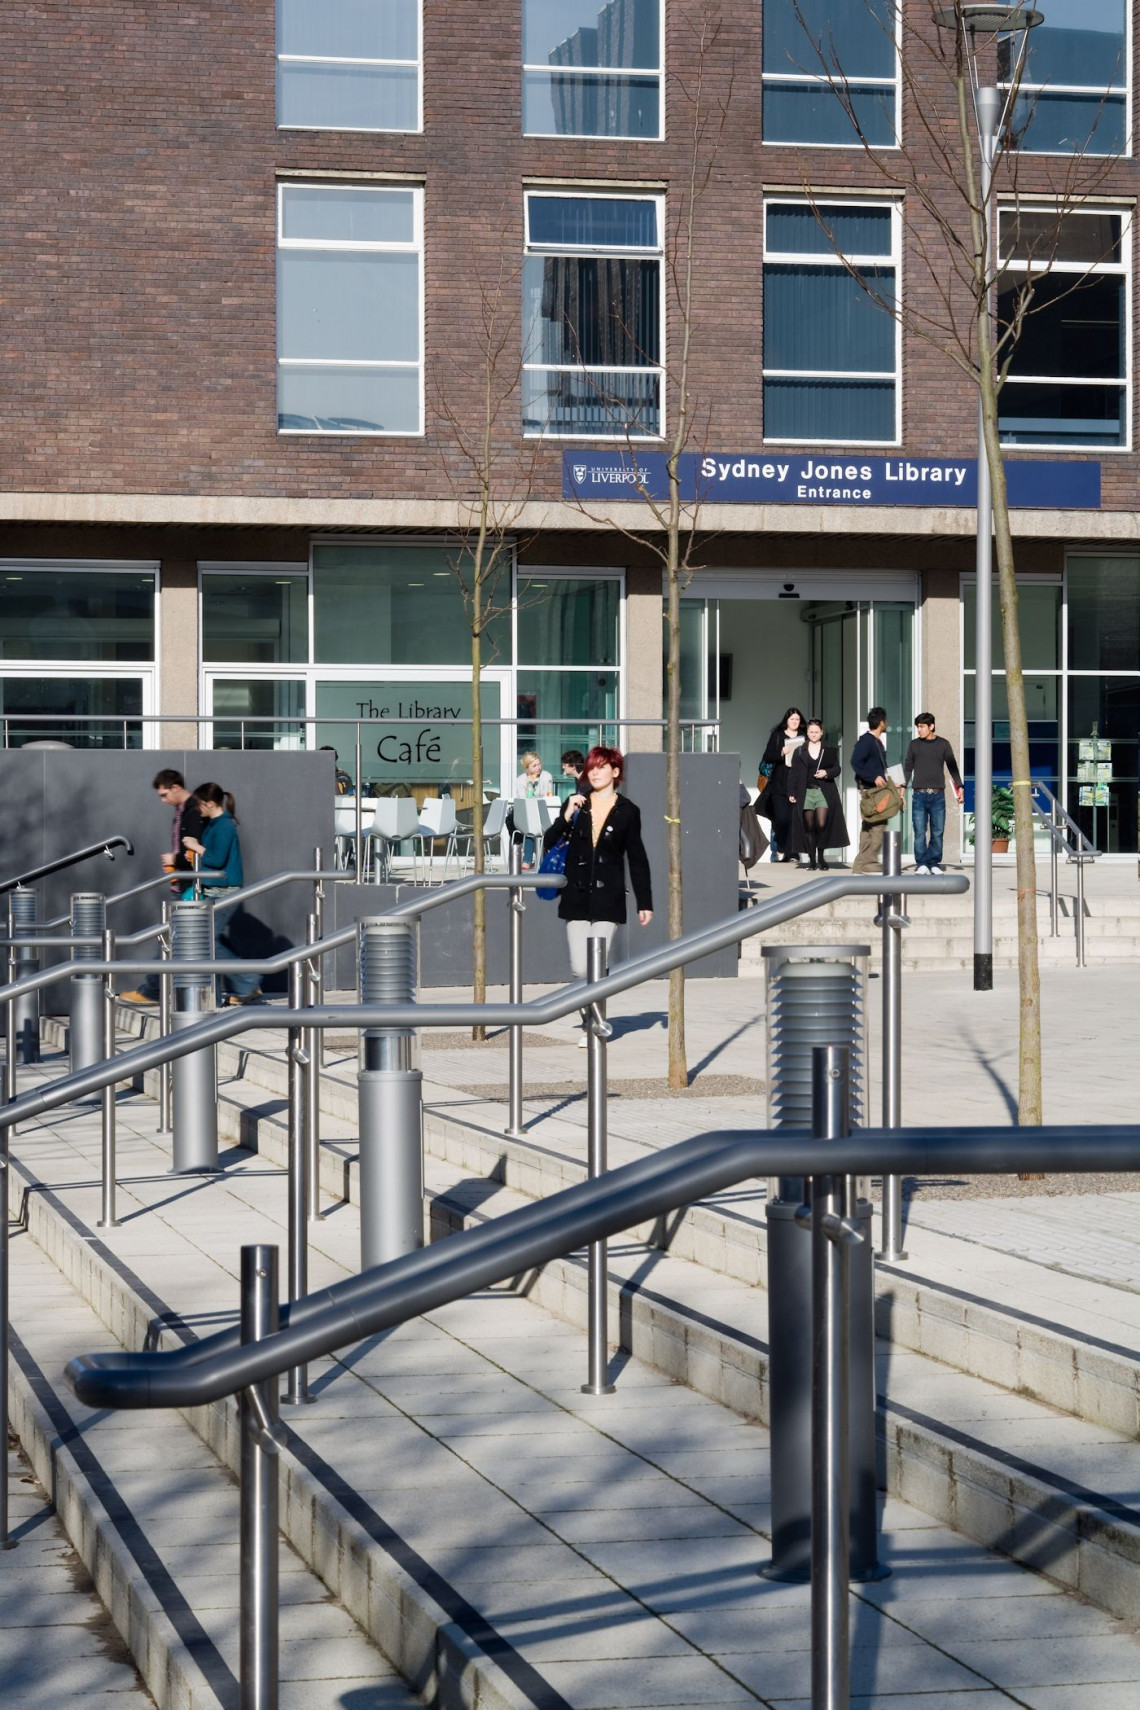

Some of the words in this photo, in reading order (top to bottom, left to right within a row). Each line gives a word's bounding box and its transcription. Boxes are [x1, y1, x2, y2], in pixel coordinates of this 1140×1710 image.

[591, 473, 649, 484] LIVERPOOL
[701, 458, 790, 482] Sydney
[801, 461, 872, 481] Jones
[885, 462, 967, 486] Library
[797, 485, 872, 499] Entrance
[356, 699, 390, 718] The
[398, 700, 461, 726] Library
[377, 728, 441, 765] Café
